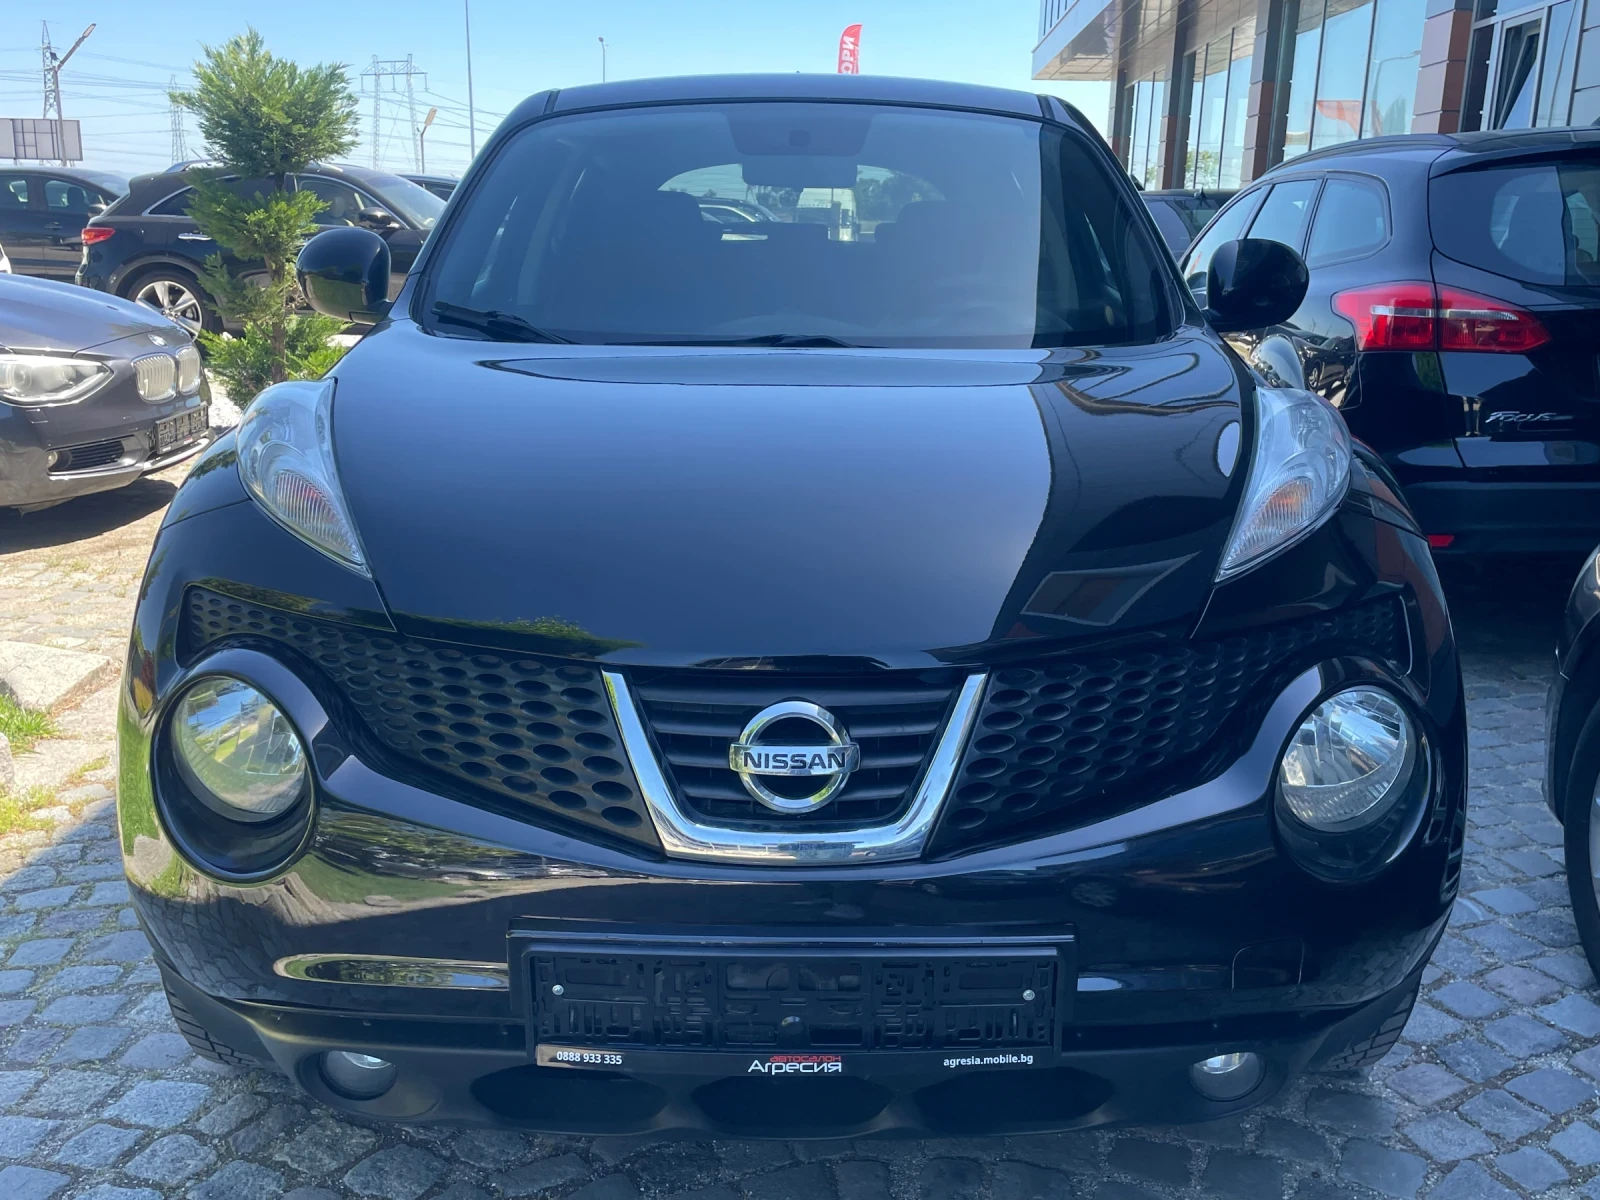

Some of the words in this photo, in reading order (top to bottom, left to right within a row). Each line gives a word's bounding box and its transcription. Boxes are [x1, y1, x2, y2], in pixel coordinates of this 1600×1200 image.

[743, 752, 846, 770] NISSAN
[556, 1051, 581, 1062] 0888
[583, 1053, 602, 1064] 933
[603, 1054, 623, 1065] 335
[943, 1053, 1034, 1069] agresia.mobile.bg
[747, 1060, 843, 1076] Агресия
